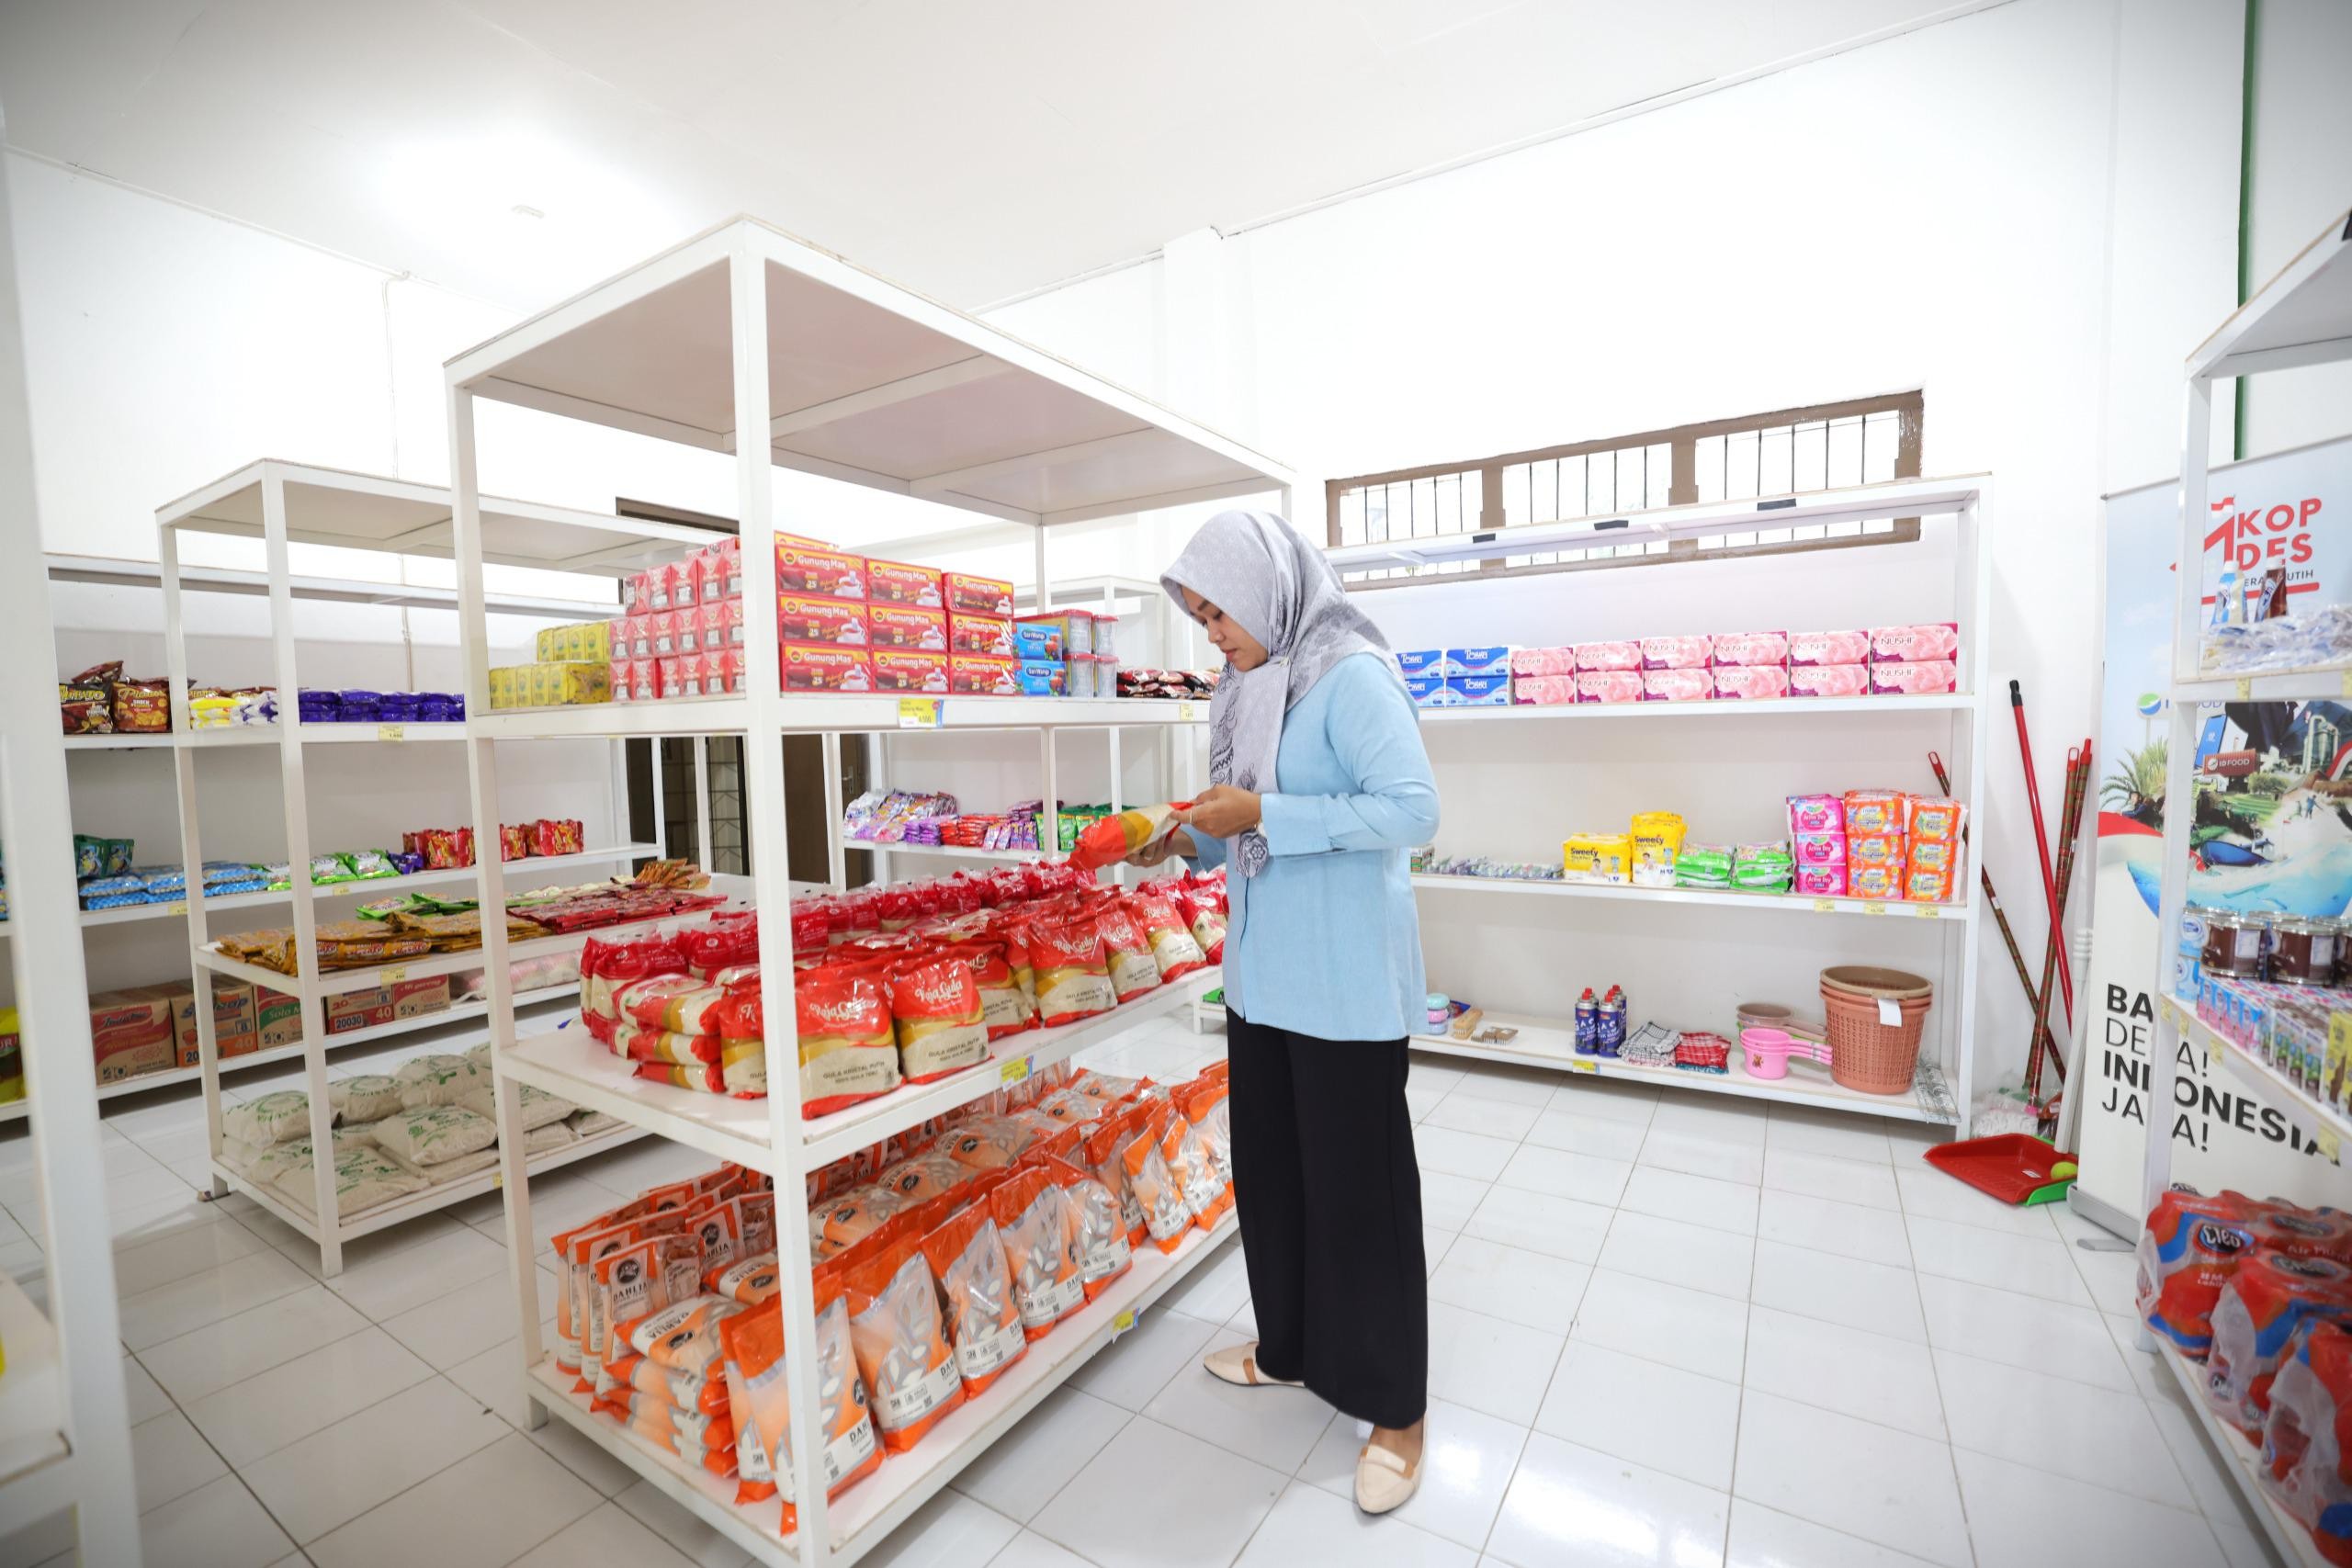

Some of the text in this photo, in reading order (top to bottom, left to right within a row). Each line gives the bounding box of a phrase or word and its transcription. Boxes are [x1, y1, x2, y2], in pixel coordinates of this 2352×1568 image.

[2237, 498, 2322, 538] KOP
[2236, 533, 2312, 571] DES
[2287, 570, 2313, 581] UTIH
[1634, 834, 1664, 845] Sweety
[1571, 847, 1599, 857] Sweety
[336, 1015, 362, 1028] 20030
[376, 1007, 391, 1019] 40
[2106, 1016, 2207, 1077] DEA!
[2102, 1087, 2209, 1153] JAA!
[2203, 1224, 2242, 1248] Cleo
